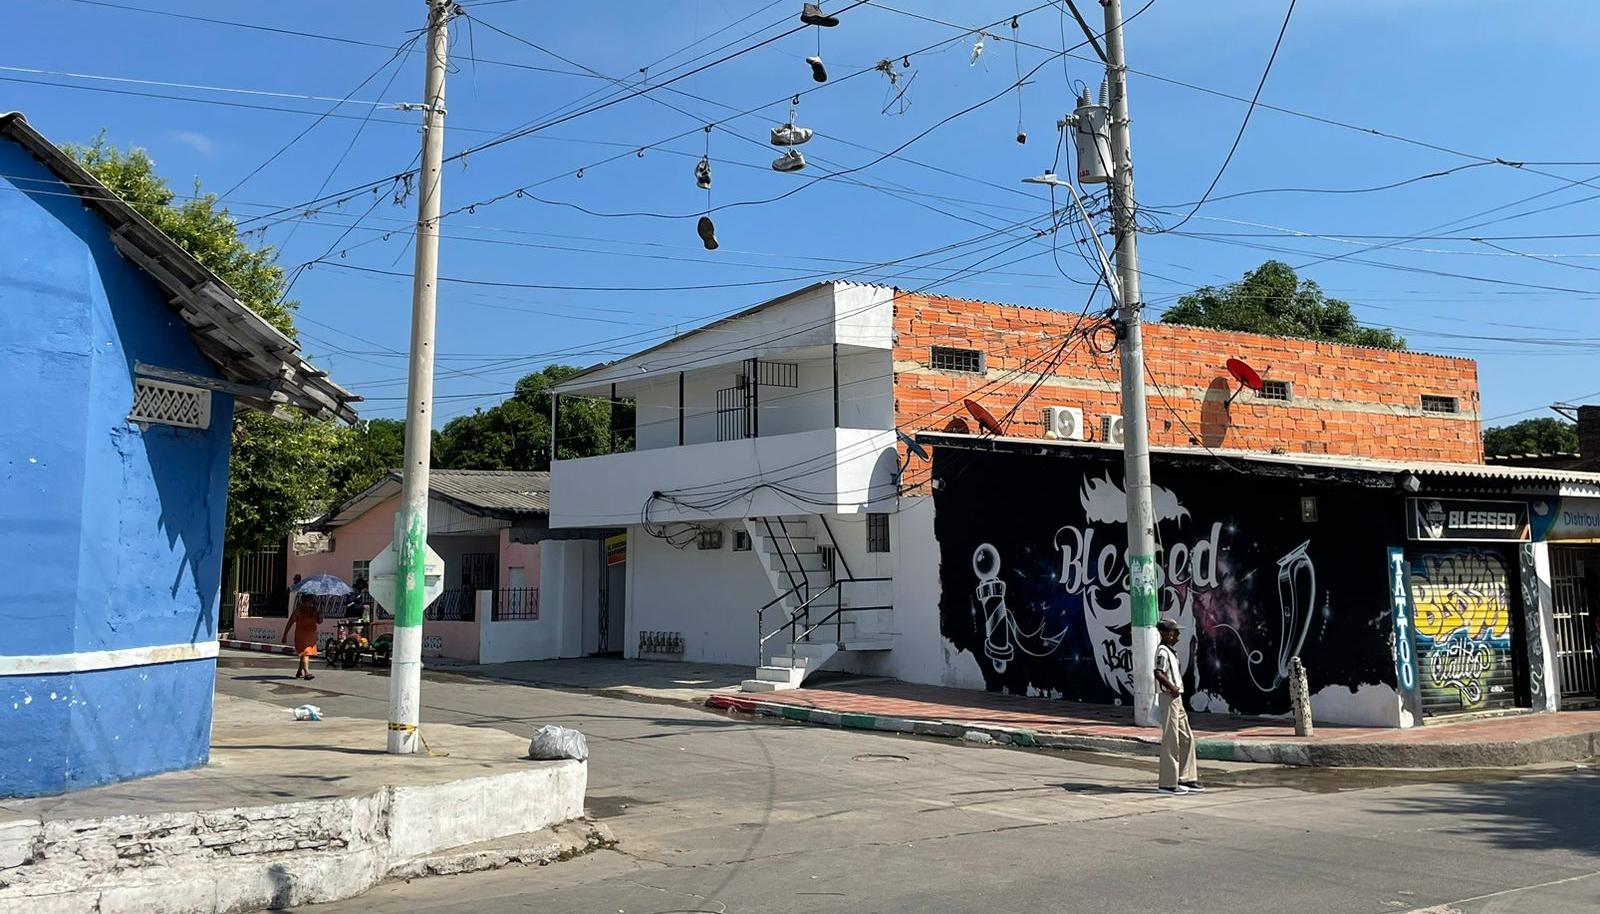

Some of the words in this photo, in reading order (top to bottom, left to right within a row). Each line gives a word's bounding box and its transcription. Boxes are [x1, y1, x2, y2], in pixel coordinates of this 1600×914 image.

[1448, 510, 1517, 530] BLESSED
[1054, 522, 1223, 594] Bleed
[1391, 553, 1414, 687] TATTOO
